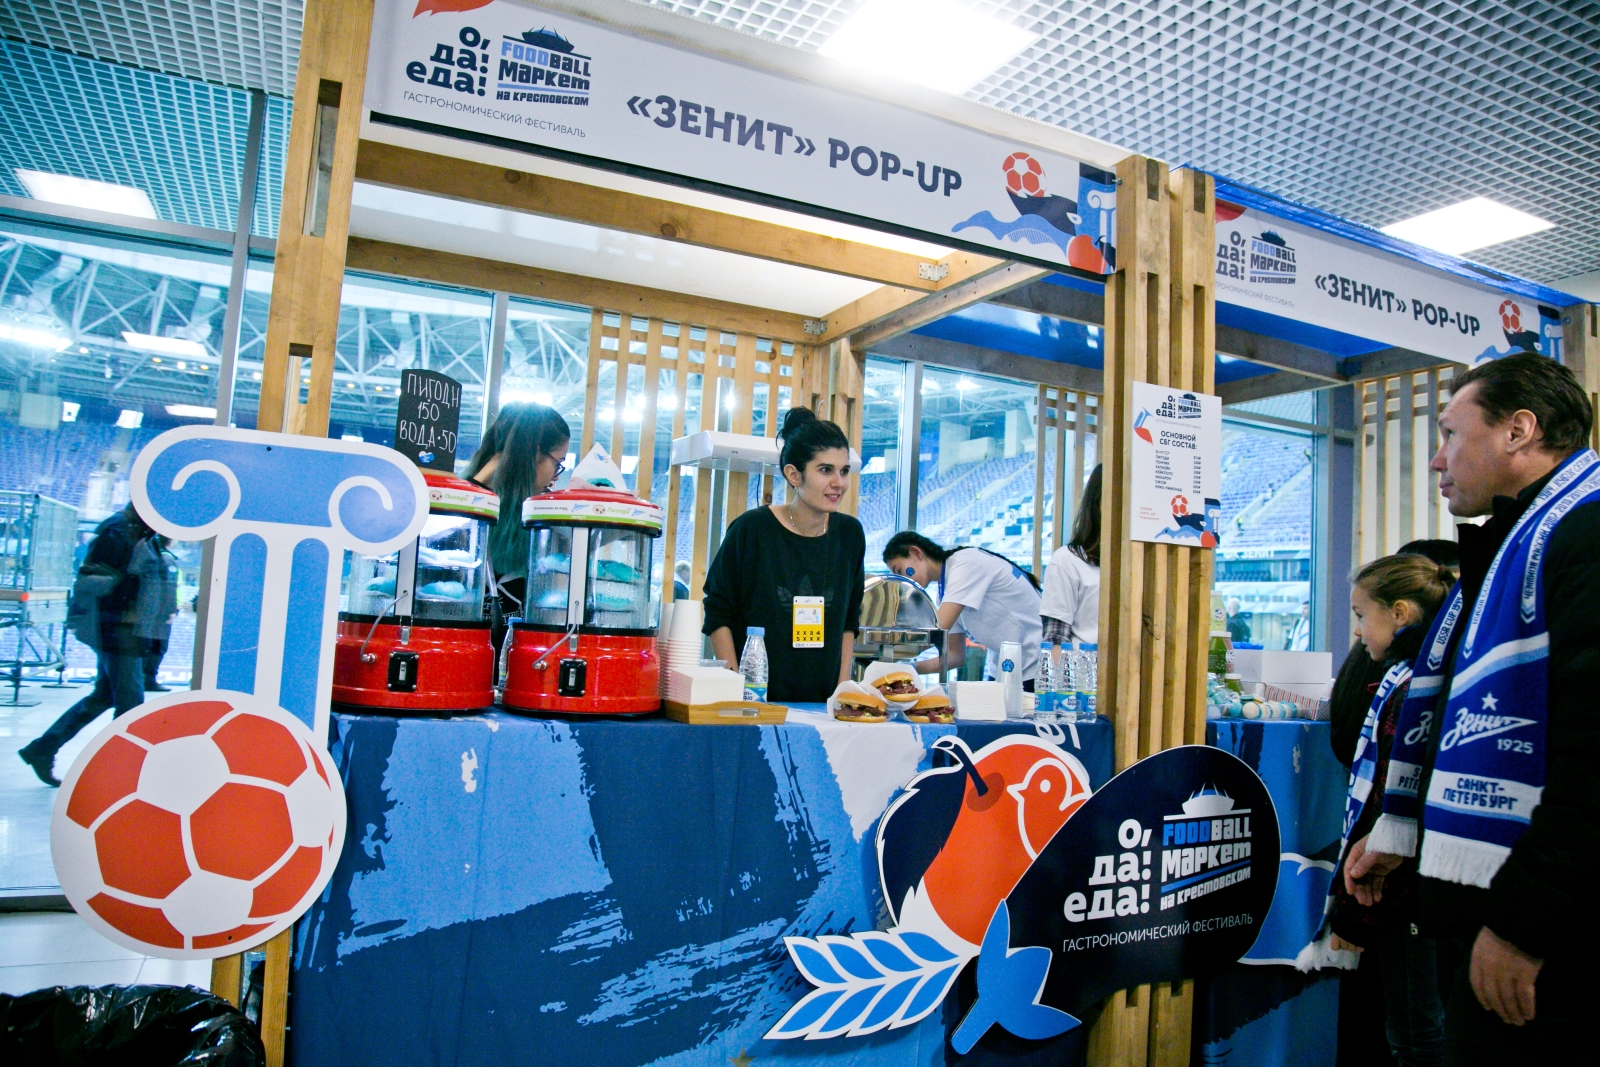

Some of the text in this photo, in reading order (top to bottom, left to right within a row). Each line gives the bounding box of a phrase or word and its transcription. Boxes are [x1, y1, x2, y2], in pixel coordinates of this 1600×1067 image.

[430, 43, 489, 74] да!
[405, 61, 486, 97] еда!
[403, 91, 586, 138] ГАСТРОНОМИЧЕСКИЙ ФЕСТИВАЛЬ
[626, 95, 962, 197] «ЗЕНИТ» POP-UP
[1217, 244, 1245, 264] да!
[1314, 274, 1480, 337] «ЗЕНИТ» POP-UP
[417, 401, 440, 421] 150
[1161, 431, 1196, 442] ОСНОВНОЙ
[1172, 440, 1197, 450] СОСТАВ:
[1524, 561, 1538, 600] ЧЕМПИОН
[1436, 626, 1450, 645] USSR
[1445, 611, 1456, 627] CUP
[1440, 707, 1538, 752] Зенит
[1497, 738, 1534, 755] 1925
[1443, 788, 1519, 810] ПЕТЕРБУРГ
[1457, 777, 1505, 794] САНКТ-
[1088, 851, 1151, 886] да!
[1064, 884, 1150, 922] еда!
[1160, 894, 1175, 911] на
[1063, 913, 1253, 952] ГАСТРОНОМИЧЕСКИЙ ФЕСТИВАЛЬ
